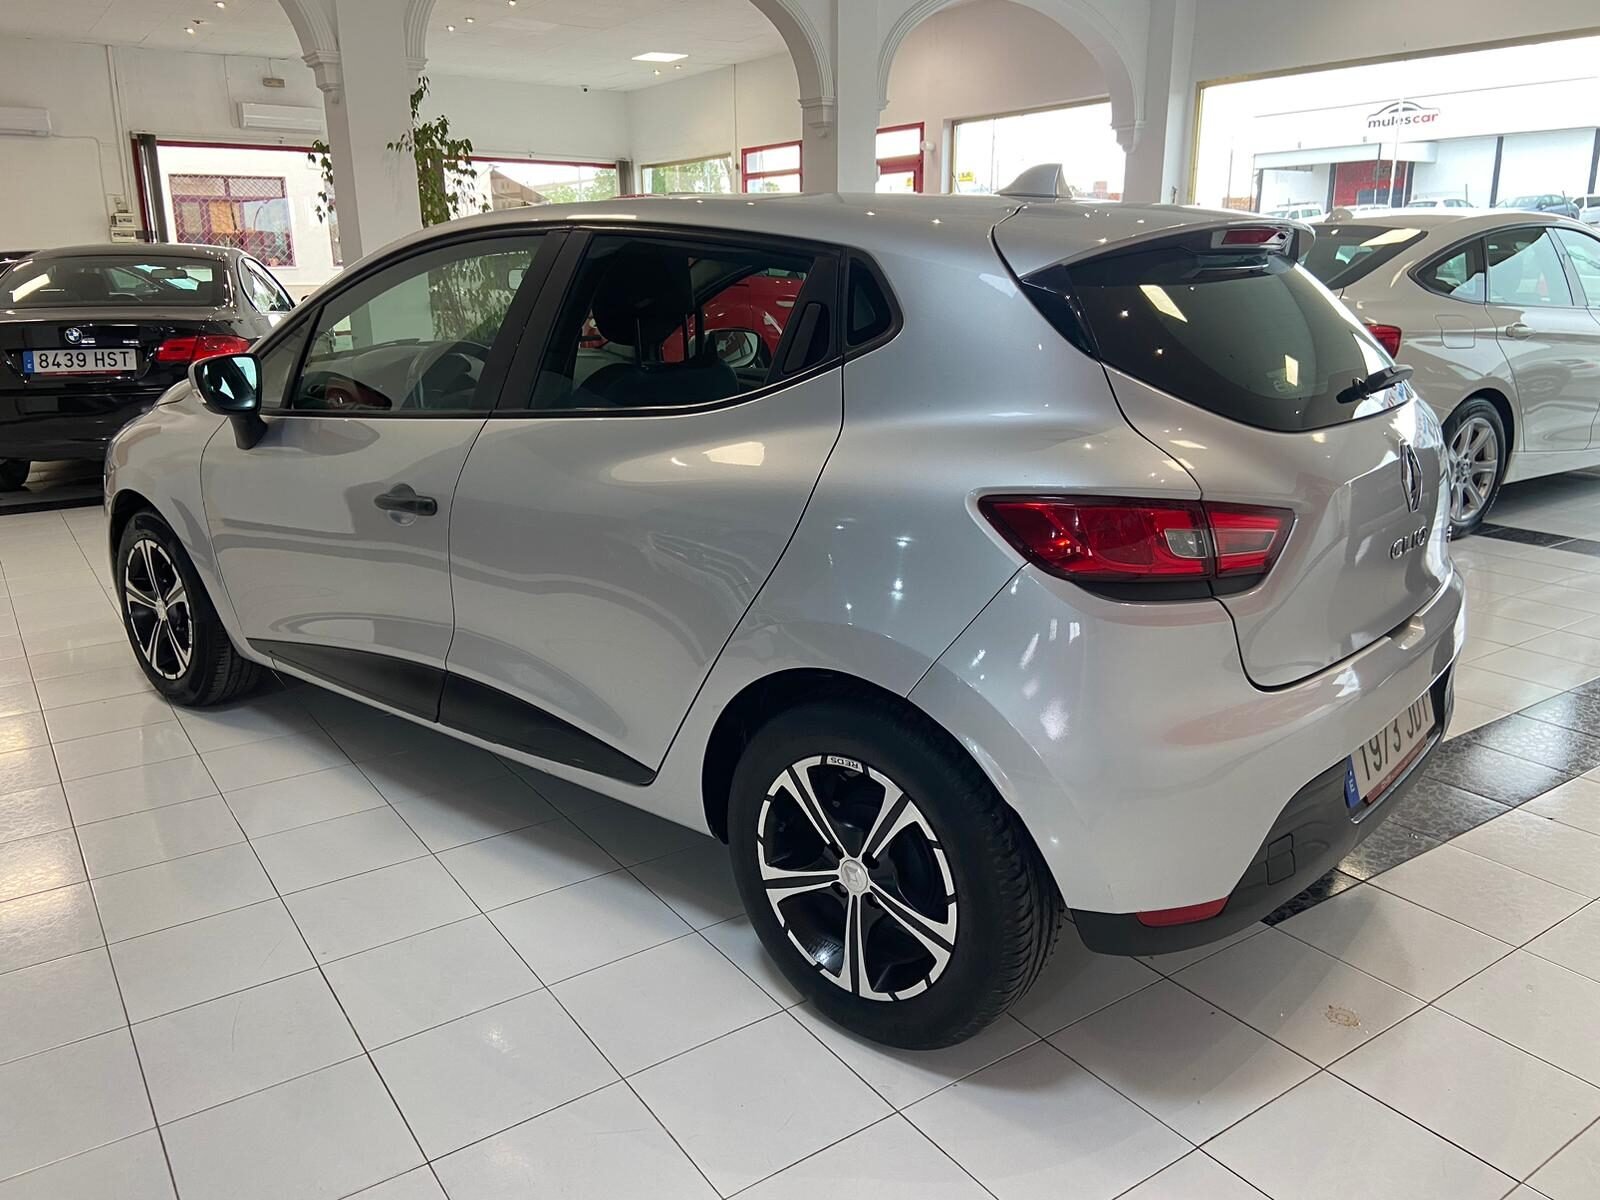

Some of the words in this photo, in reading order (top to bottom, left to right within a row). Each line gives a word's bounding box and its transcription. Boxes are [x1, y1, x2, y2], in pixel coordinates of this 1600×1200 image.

[1367, 113, 1439, 128] mulescar
[39, 352, 87, 369] 8439
[94, 351, 130, 368] HST
[1389, 525, 1428, 560] CLIO
[1359, 717, 1402, 781] 1973
[830, 756, 860, 769] REDS
